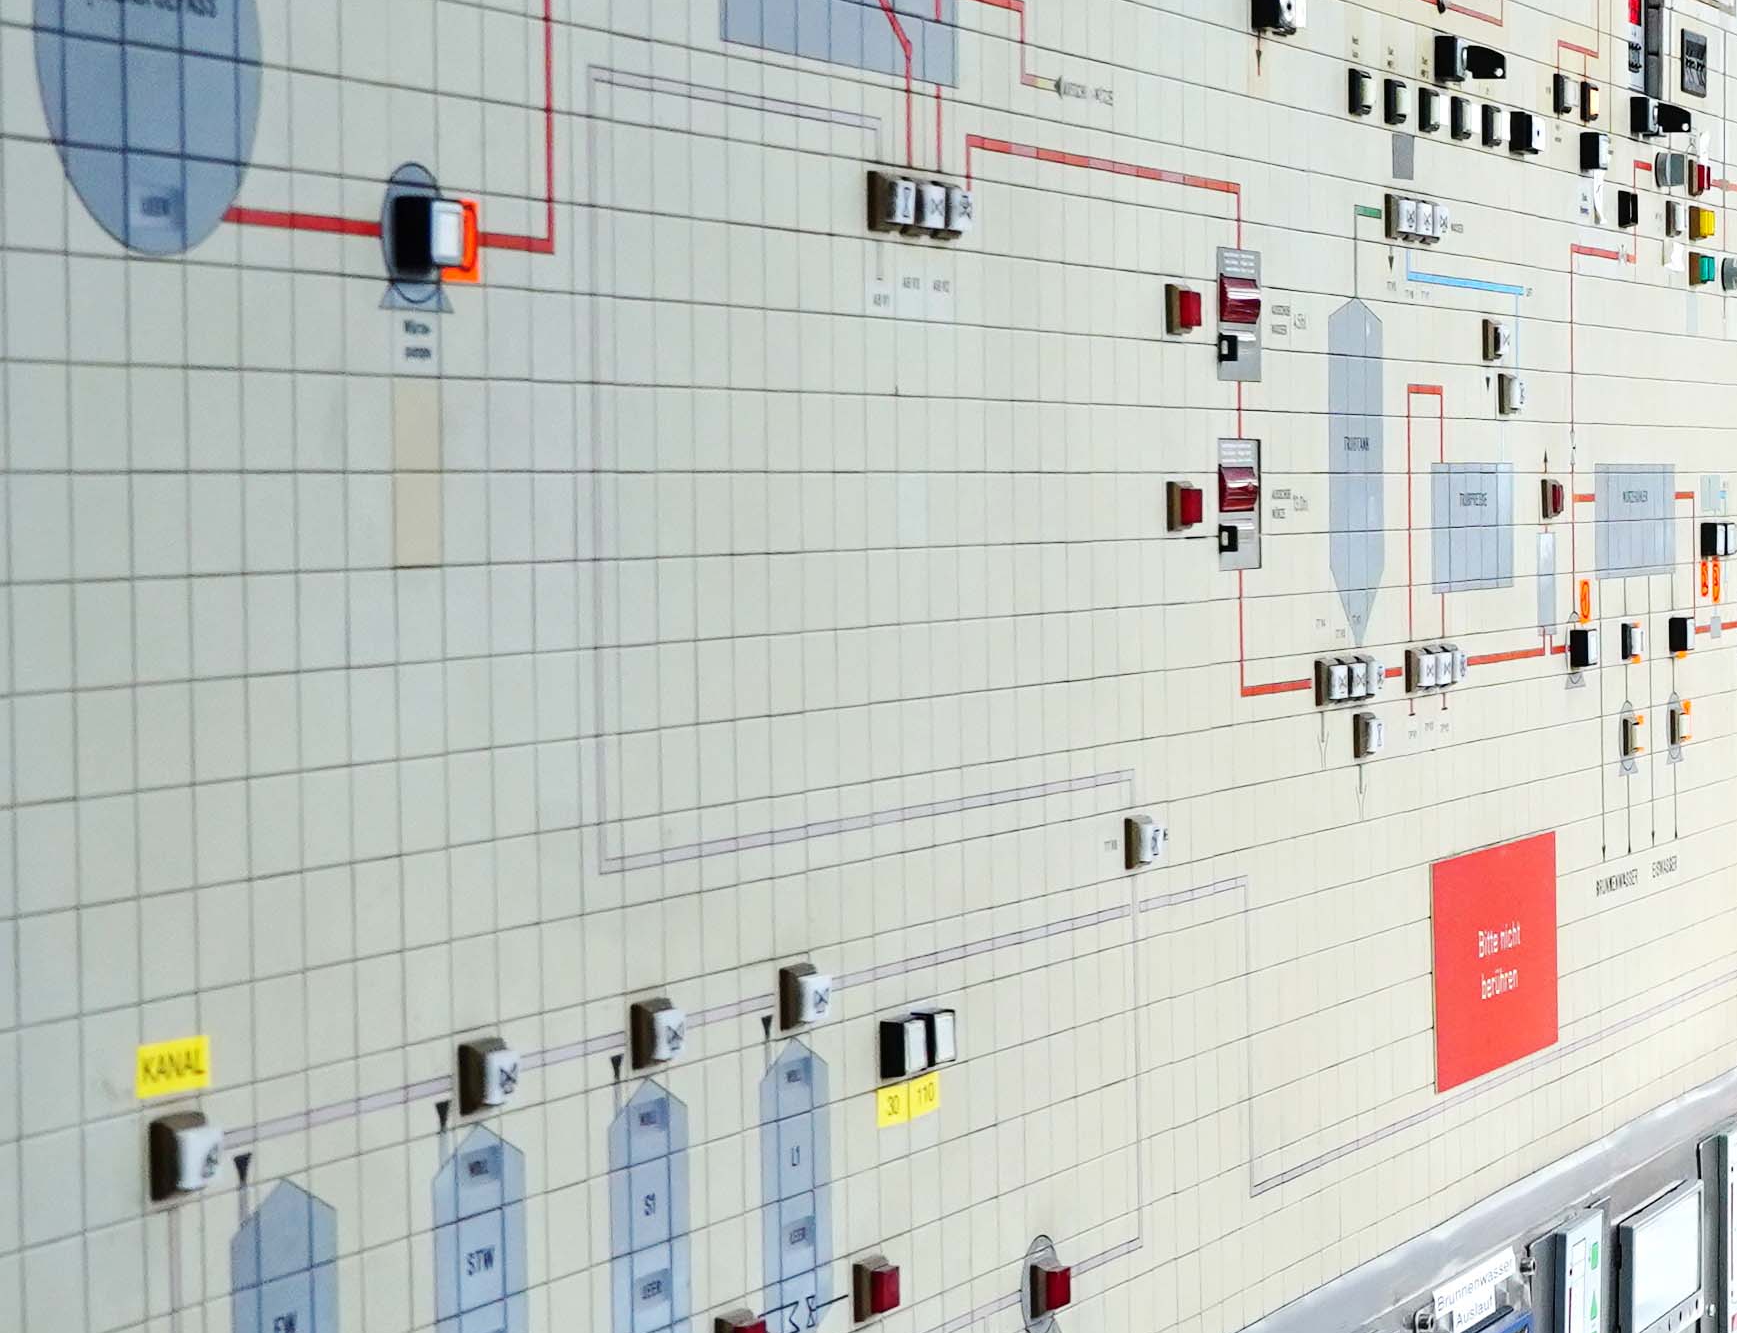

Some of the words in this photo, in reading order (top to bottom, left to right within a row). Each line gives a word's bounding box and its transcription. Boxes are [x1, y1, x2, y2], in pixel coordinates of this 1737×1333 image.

[1478, 930, 1500, 958] Bitte
[1500, 923, 1521, 950] nicht
[1481, 968, 1518, 1000] berühren
[141, 1049, 207, 1083] KANAL
[887, 1094, 900, 1116] 30
[917, 1083, 935, 1105] 110
[1438, 1258, 1512, 1312] Brunnenwasser
[1456, 1294, 1493, 1328] Auslauf
